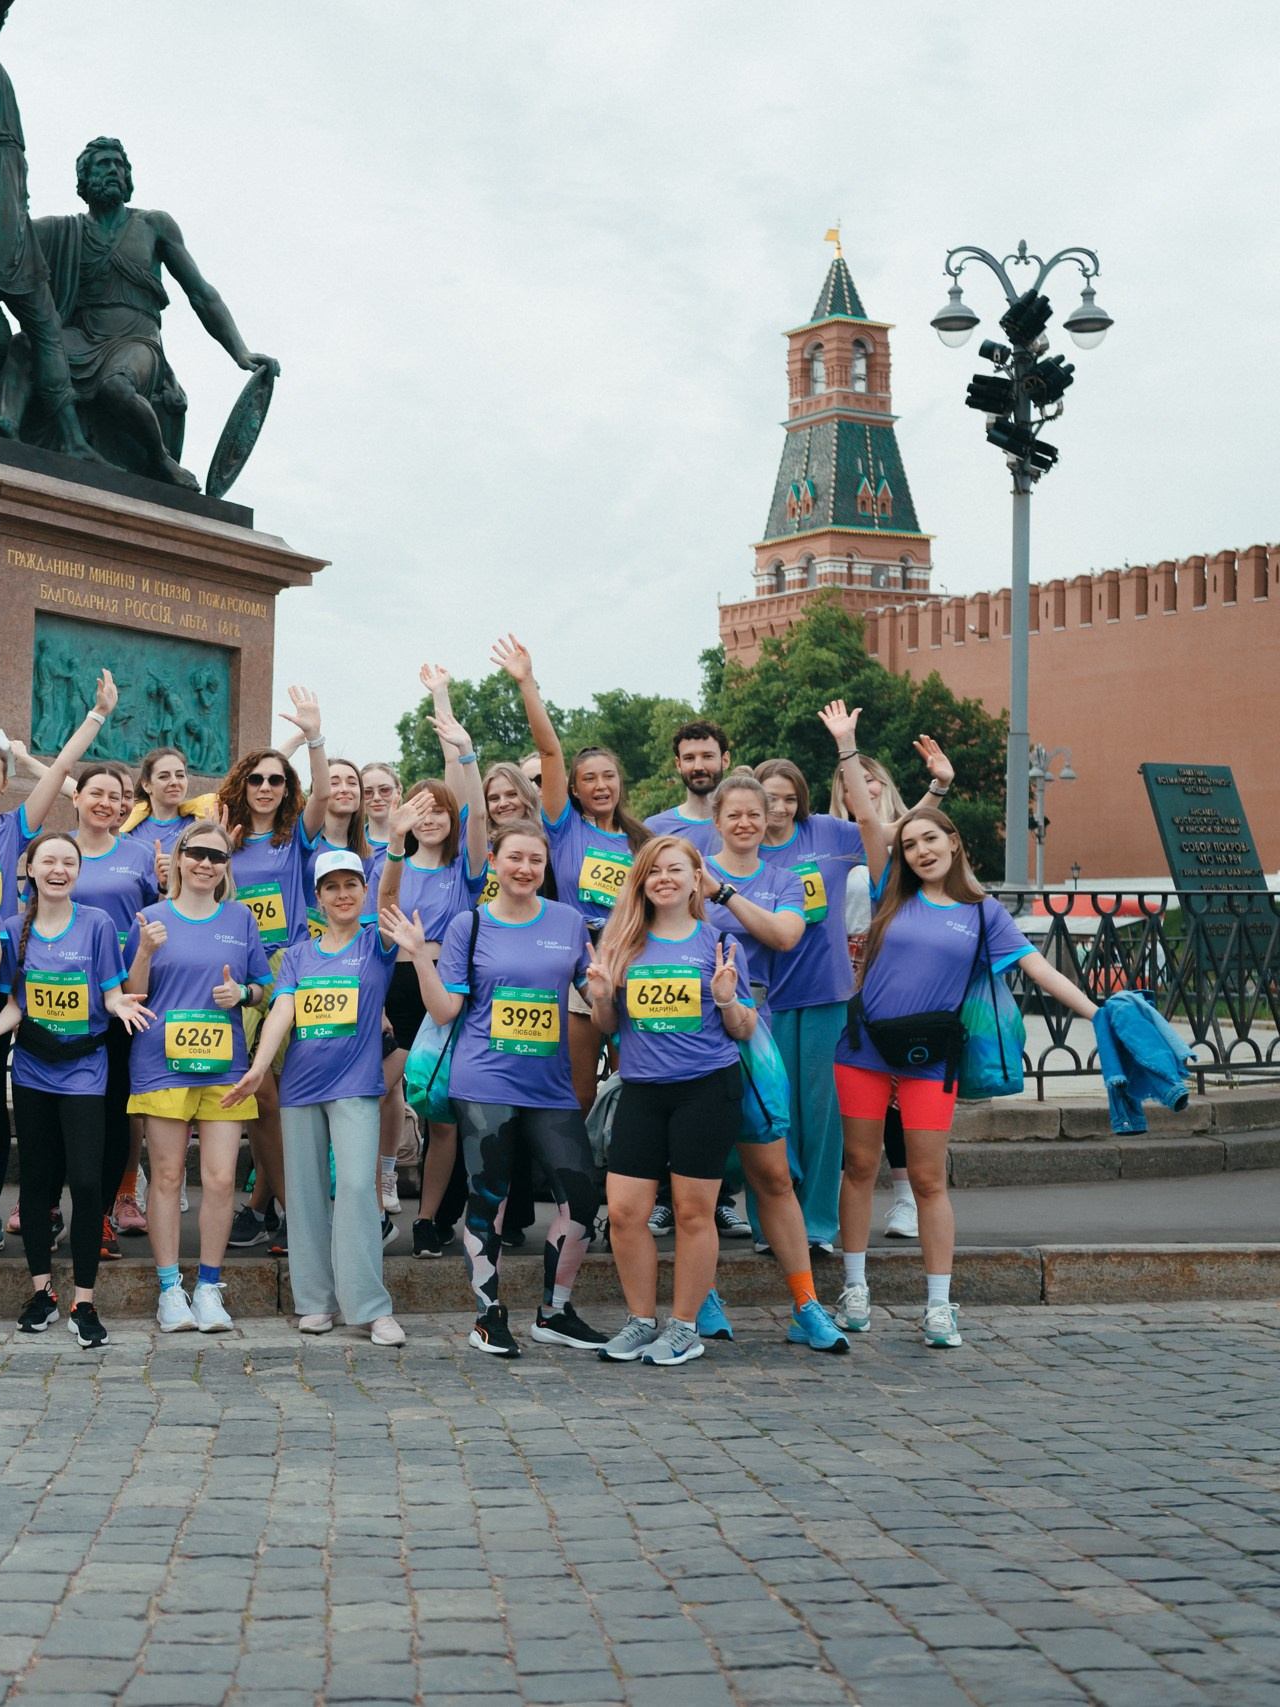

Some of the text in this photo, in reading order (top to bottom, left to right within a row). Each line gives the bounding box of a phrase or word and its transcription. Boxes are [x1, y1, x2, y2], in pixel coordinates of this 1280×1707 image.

[7, 549, 267, 618] ГРАЖДАНИНУ МИНИНУ И КНЯЗЮ ПОЖАРСКОМУ
[40, 583, 119, 614] БЛАГОДАРНАЯ
[218, 620, 240, 637] 1818
[1181, 842, 1211, 852] СОБОР
[1198, 854, 1214, 864] ЧТО
[1216, 855, 1228, 864] НА
[590, 864, 626, 886] 628
[583, 890, 591, 901] D
[34, 989, 79, 1009] 5148
[303, 994, 348, 1013] 6289
[637, 985, 690, 1005] 6264
[502, 1007, 552, 1029] 3993
[175, 1028, 224, 1047] 6267
[512, 1028, 542, 1036] ЛЮБОВЬ
